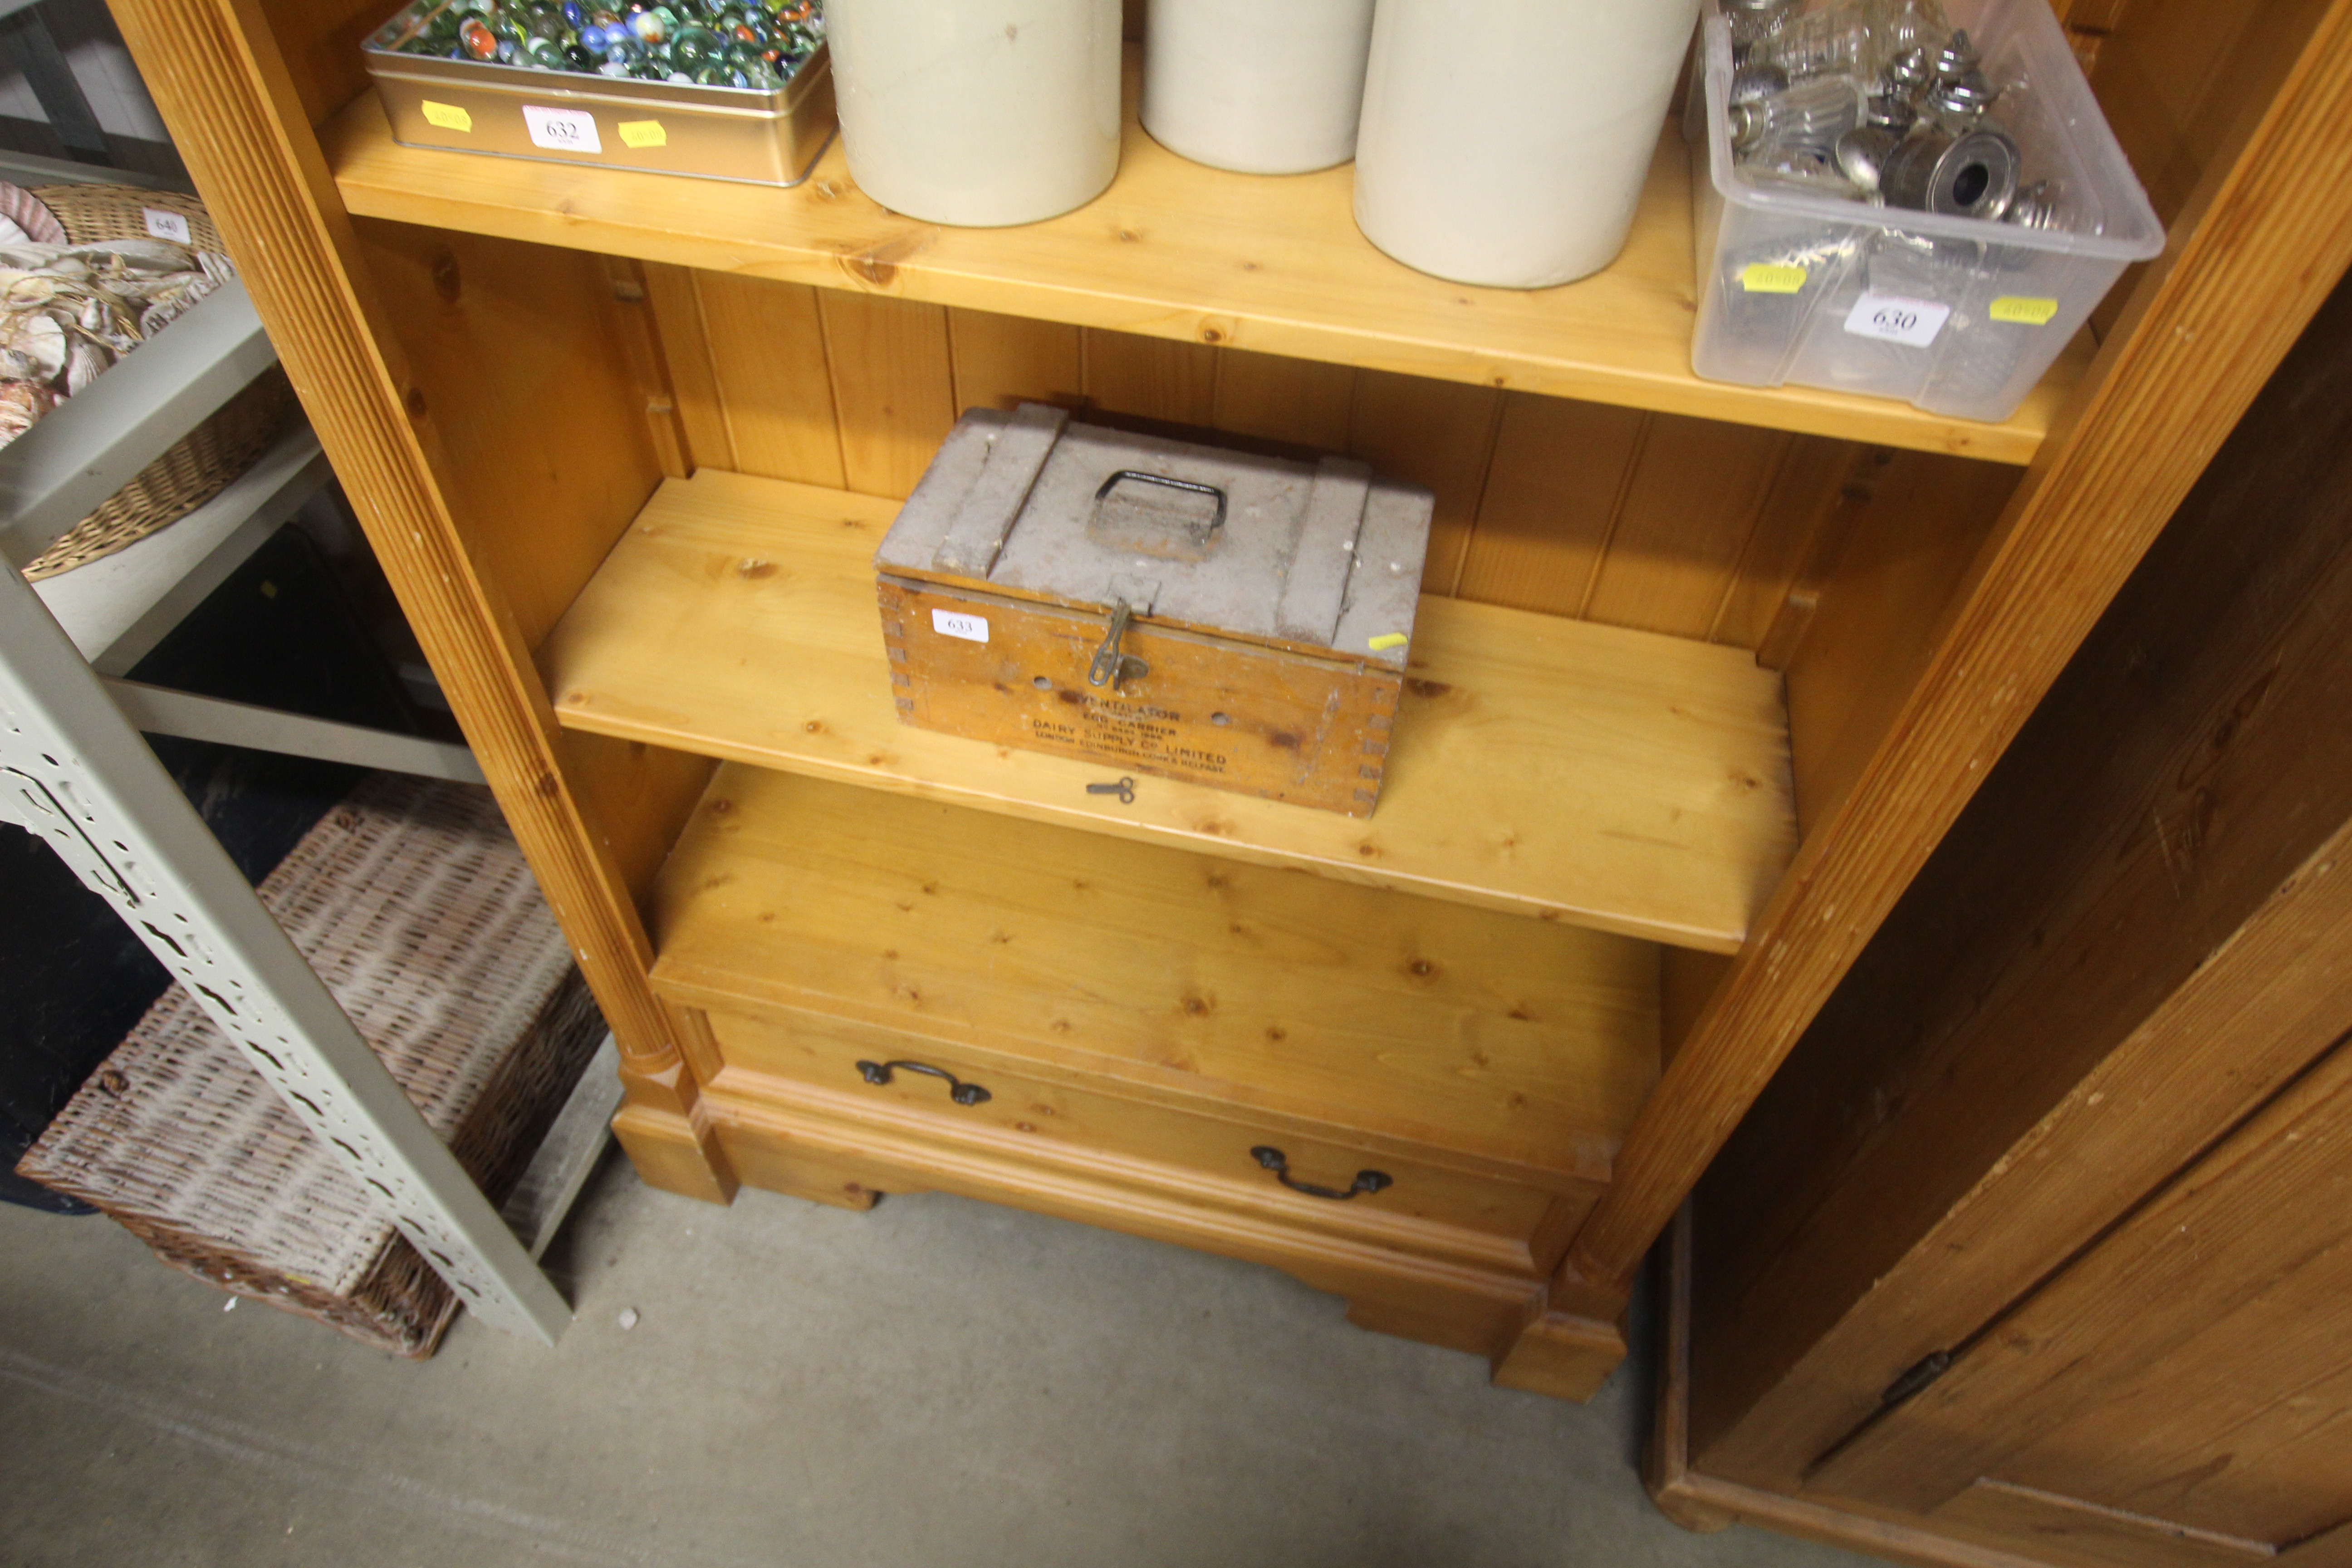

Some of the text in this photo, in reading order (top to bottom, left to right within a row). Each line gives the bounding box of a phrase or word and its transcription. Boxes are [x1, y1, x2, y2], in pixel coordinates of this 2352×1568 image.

[547, 120, 579, 139] 632
[156, 219, 178, 233] 640
[1873, 307, 1917, 331] 630
[948, 619, 972, 632] 633
[1078, 695, 1180, 721] VENTILATOR
[1117, 719, 1176, 736] CARRIER
[1034, 719, 1074, 734] DAIRY
[1084, 728, 1135, 745] SUPPLY
[1166, 745, 1227, 764] LIMITED
